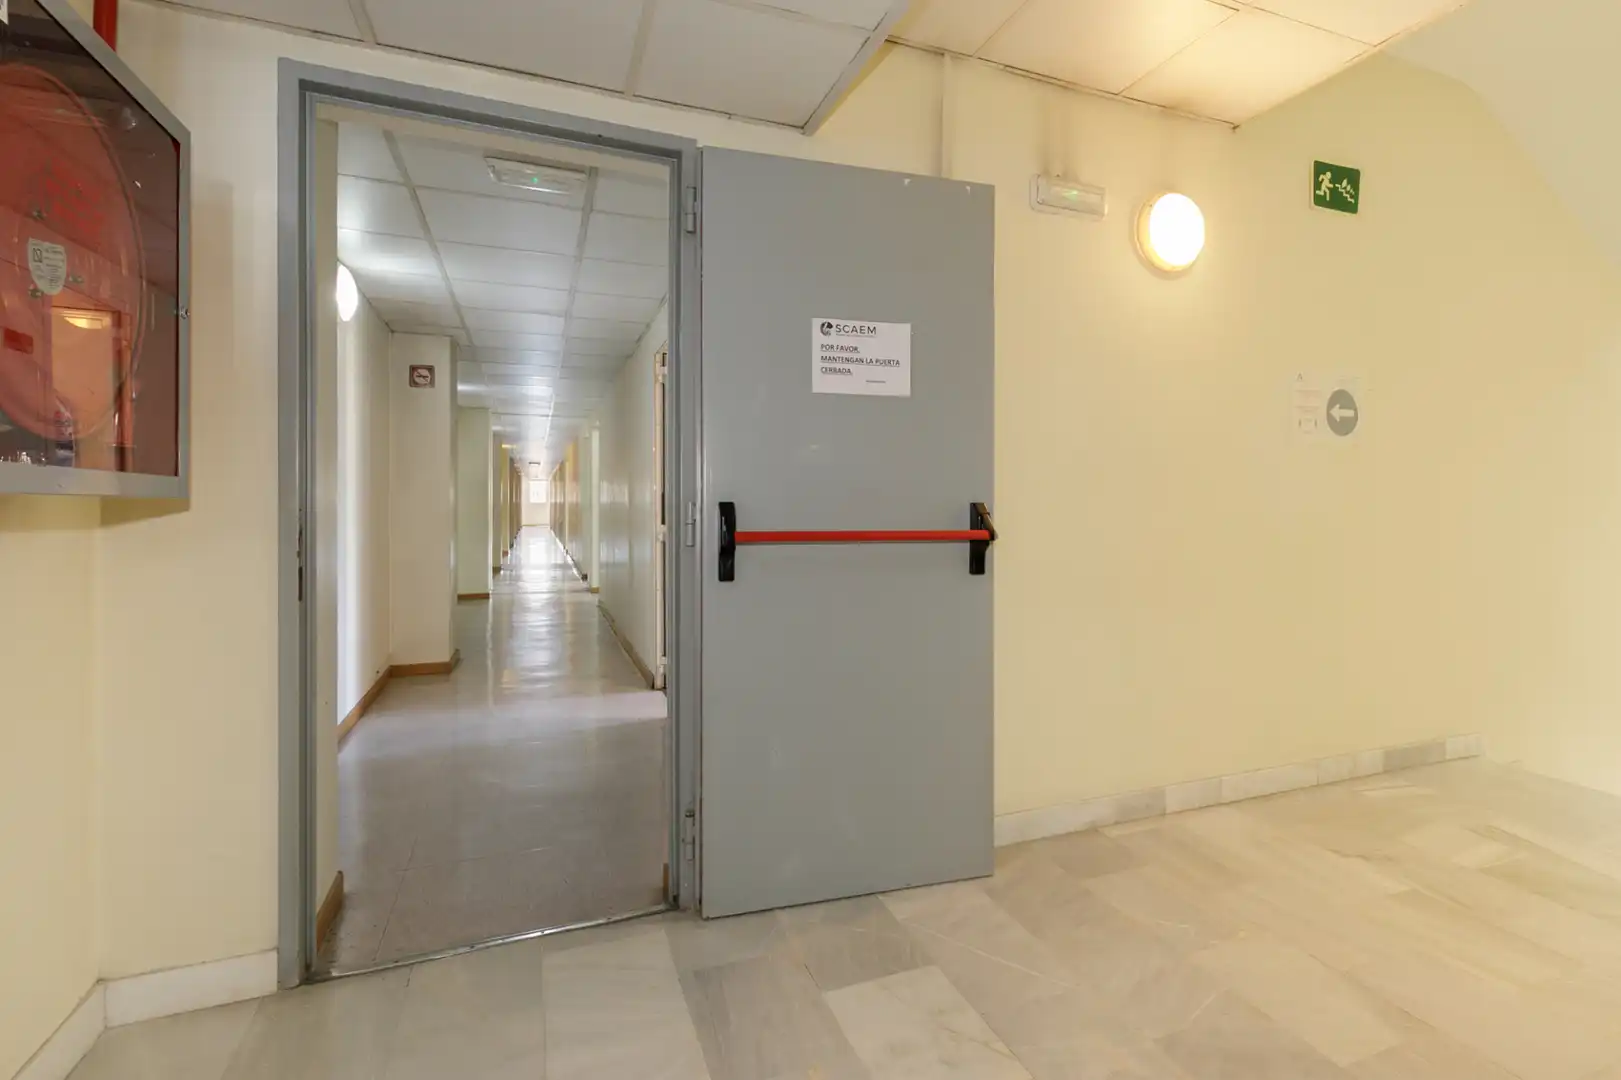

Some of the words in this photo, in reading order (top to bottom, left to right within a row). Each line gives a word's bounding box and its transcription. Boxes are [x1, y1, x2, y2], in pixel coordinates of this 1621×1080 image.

[835, 324, 877, 335] SCAEM
[820, 343, 834, 351] POR
[820, 355, 864, 365] MANTENGAN
[865, 357, 873, 365] LA
[875, 358, 901, 366] PUERTA
